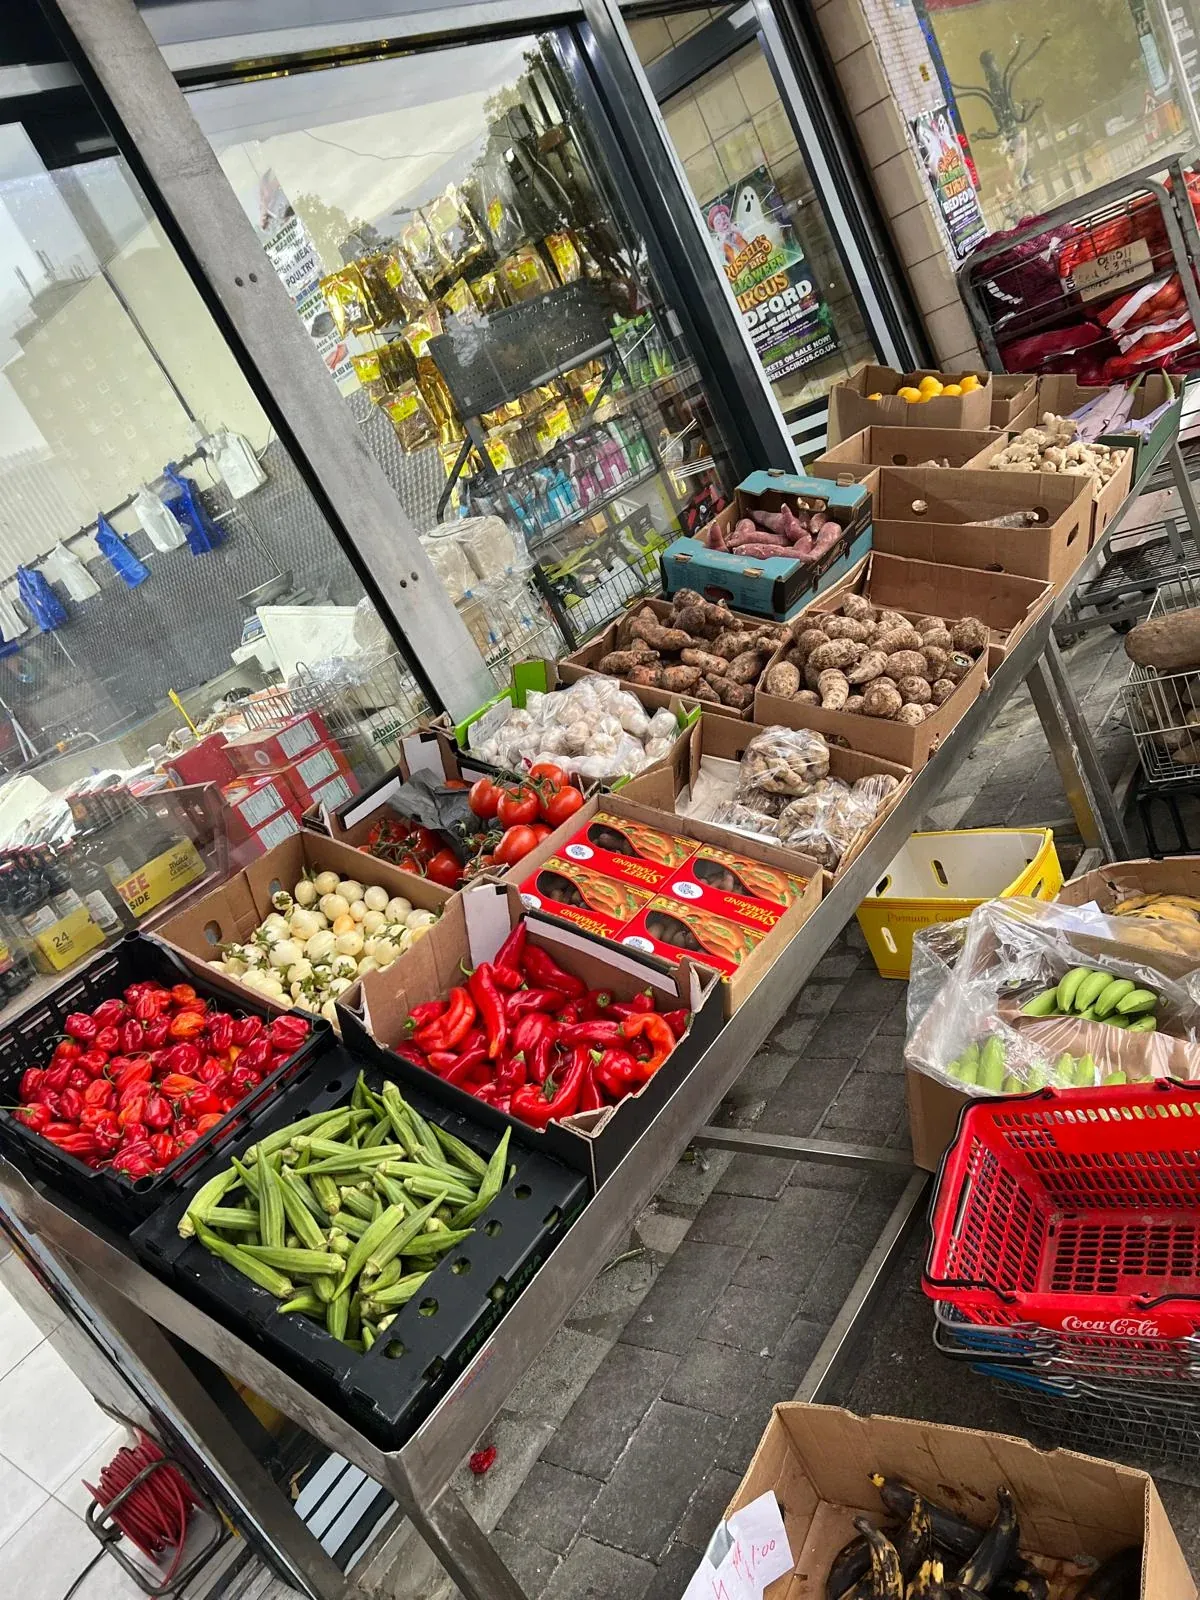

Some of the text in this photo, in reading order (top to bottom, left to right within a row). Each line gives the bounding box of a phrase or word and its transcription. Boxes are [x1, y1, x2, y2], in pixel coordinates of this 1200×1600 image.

[748, 253, 767, 269] BIG
[285, 258, 315, 288] POULTRY
[736, 272, 789, 313] IRCUS
[296, 297, 315, 315] ROZEN
[743, 280, 813, 329] DFORD
[764, 360, 783, 374] KETS
[784, 354, 795, 363] ON
[794, 345, 812, 358] SALE
[813, 335, 832, 348] NOW!
[768, 342, 837, 381] SELLSCIRCUS.CO.UK
[612, 857, 658, 878] TAMARIND
[620, 867, 665, 884] SWEET
[118, 873, 150, 901] REE
[129, 892, 151, 910] SIDE
[723, 897, 774, 917] TAMARIND
[560, 908, 607, 930] TAMARIND
[734, 908, 781, 926] SWEET
[53, 932, 69, 948] 24
[506, 1255, 542, 1300] OKRA
[458, 1304, 503, 1365] FRESH
[1061, 1315, 1160, 1337] Coca-Cola
